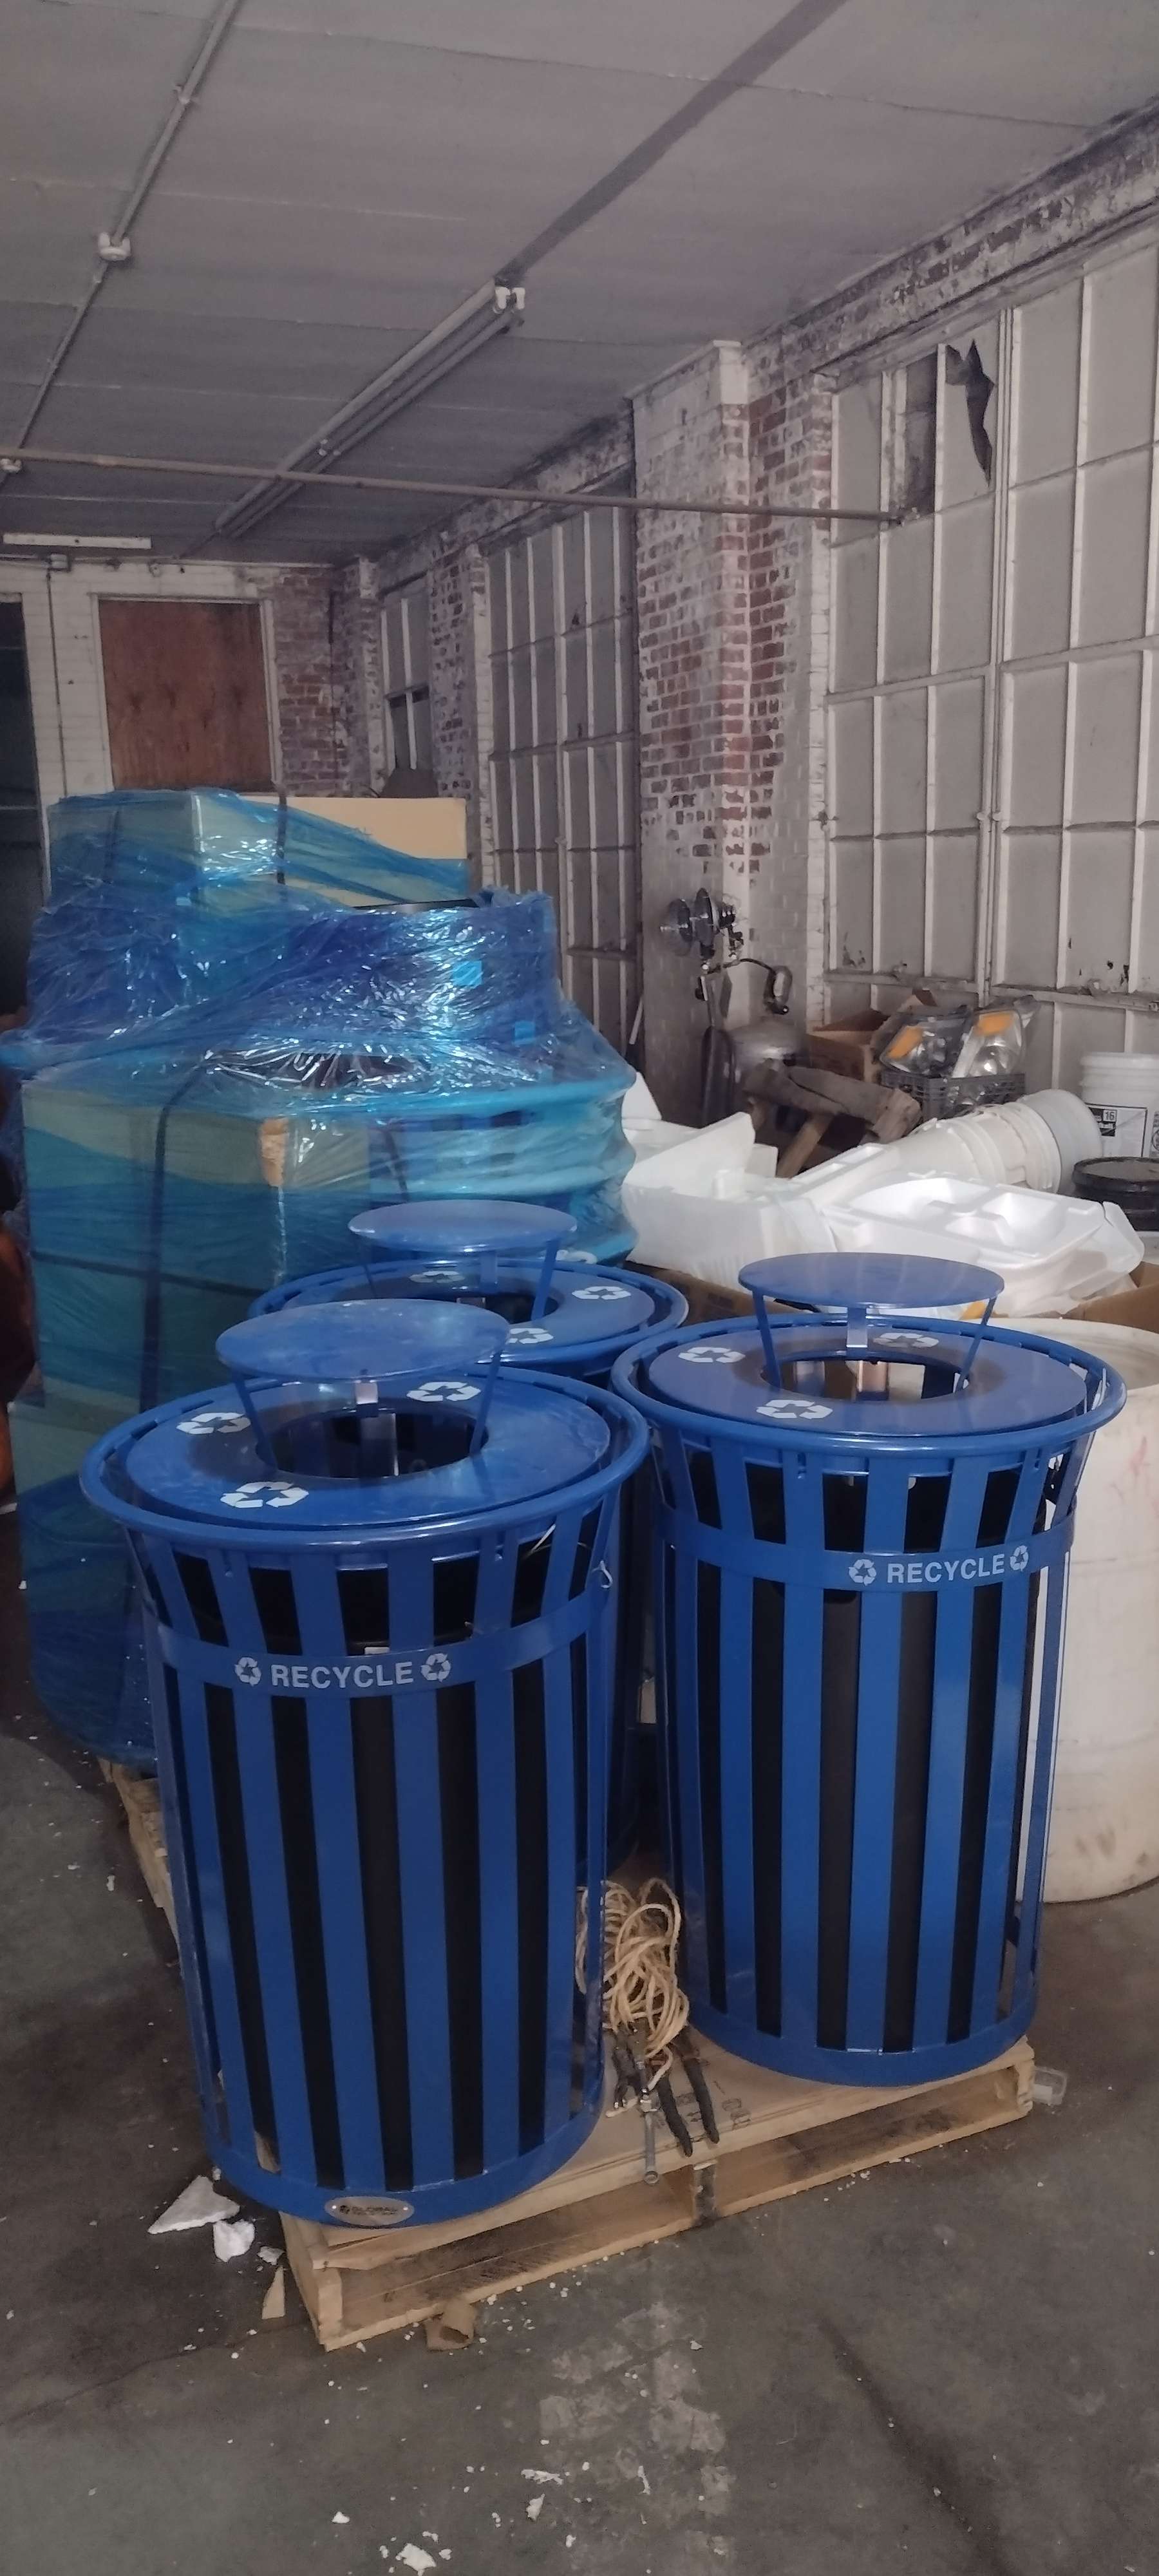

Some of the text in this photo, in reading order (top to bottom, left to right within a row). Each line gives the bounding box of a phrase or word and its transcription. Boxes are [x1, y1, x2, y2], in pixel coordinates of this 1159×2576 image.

[1105, 1111, 1115, 1121] 16
[887, 1553, 1005, 1584] RECYCLE
[270, 1662, 414, 1689] RECYCLE
